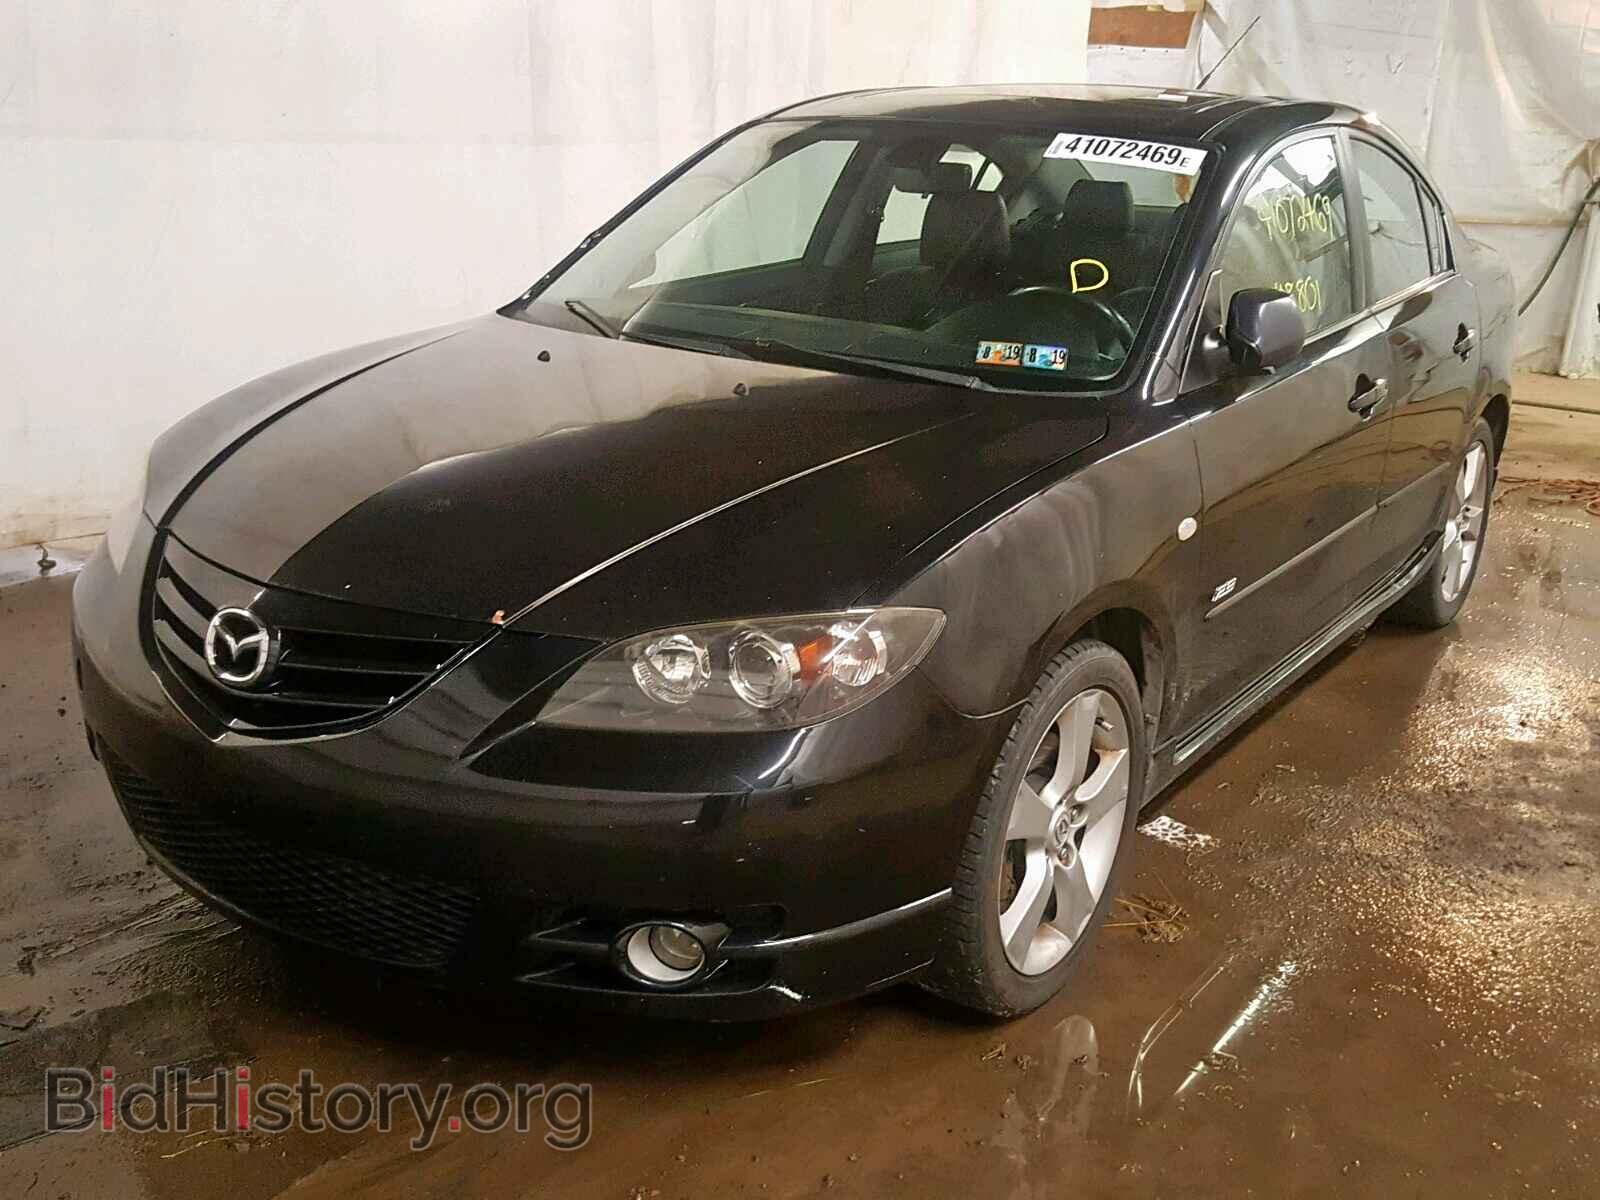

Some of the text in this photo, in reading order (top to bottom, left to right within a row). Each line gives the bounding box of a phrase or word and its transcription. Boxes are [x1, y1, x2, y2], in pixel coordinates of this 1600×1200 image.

[1070, 258, 1109, 294] D
[1007, 345, 1020, 360] 19
[1028, 348, 1066, 365] 8 19
